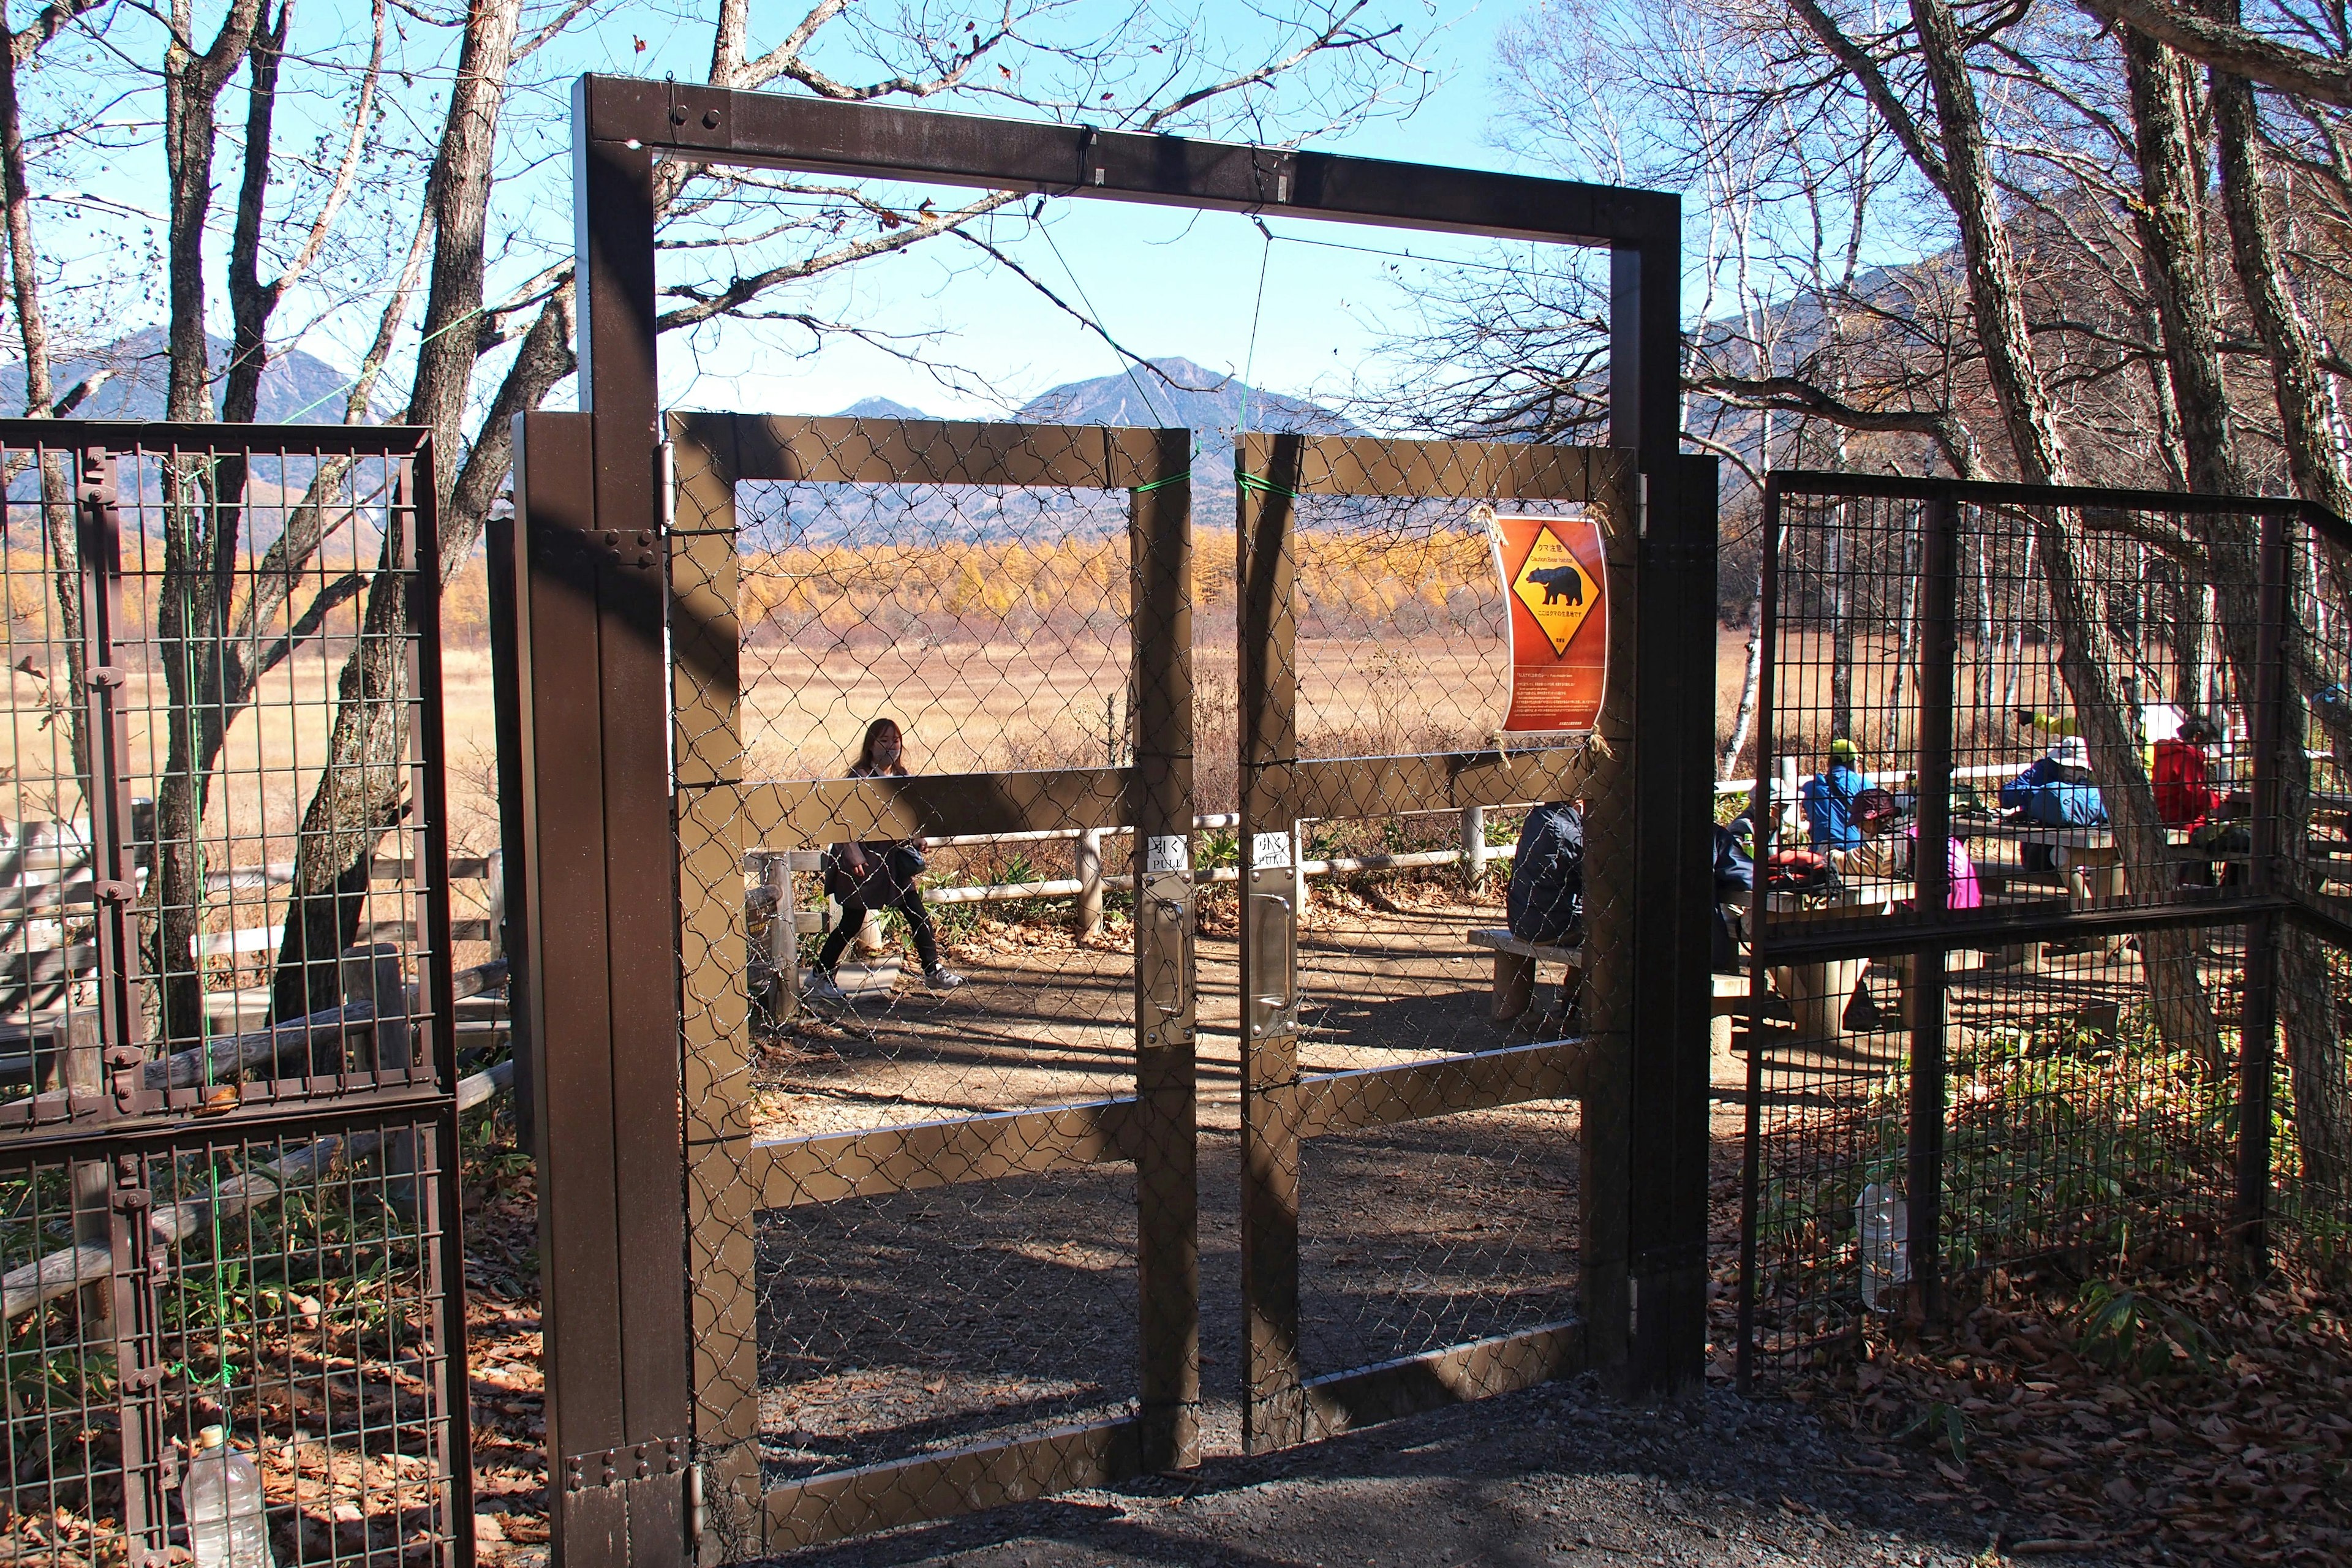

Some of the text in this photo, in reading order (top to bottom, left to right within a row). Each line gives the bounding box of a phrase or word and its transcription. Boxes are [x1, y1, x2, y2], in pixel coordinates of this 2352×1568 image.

[1155, 840, 1177, 853] 引く
[1259, 837, 1280, 850] 引く
[1153, 859, 1182, 869] PULL
[1259, 856, 1286, 865] PULL
